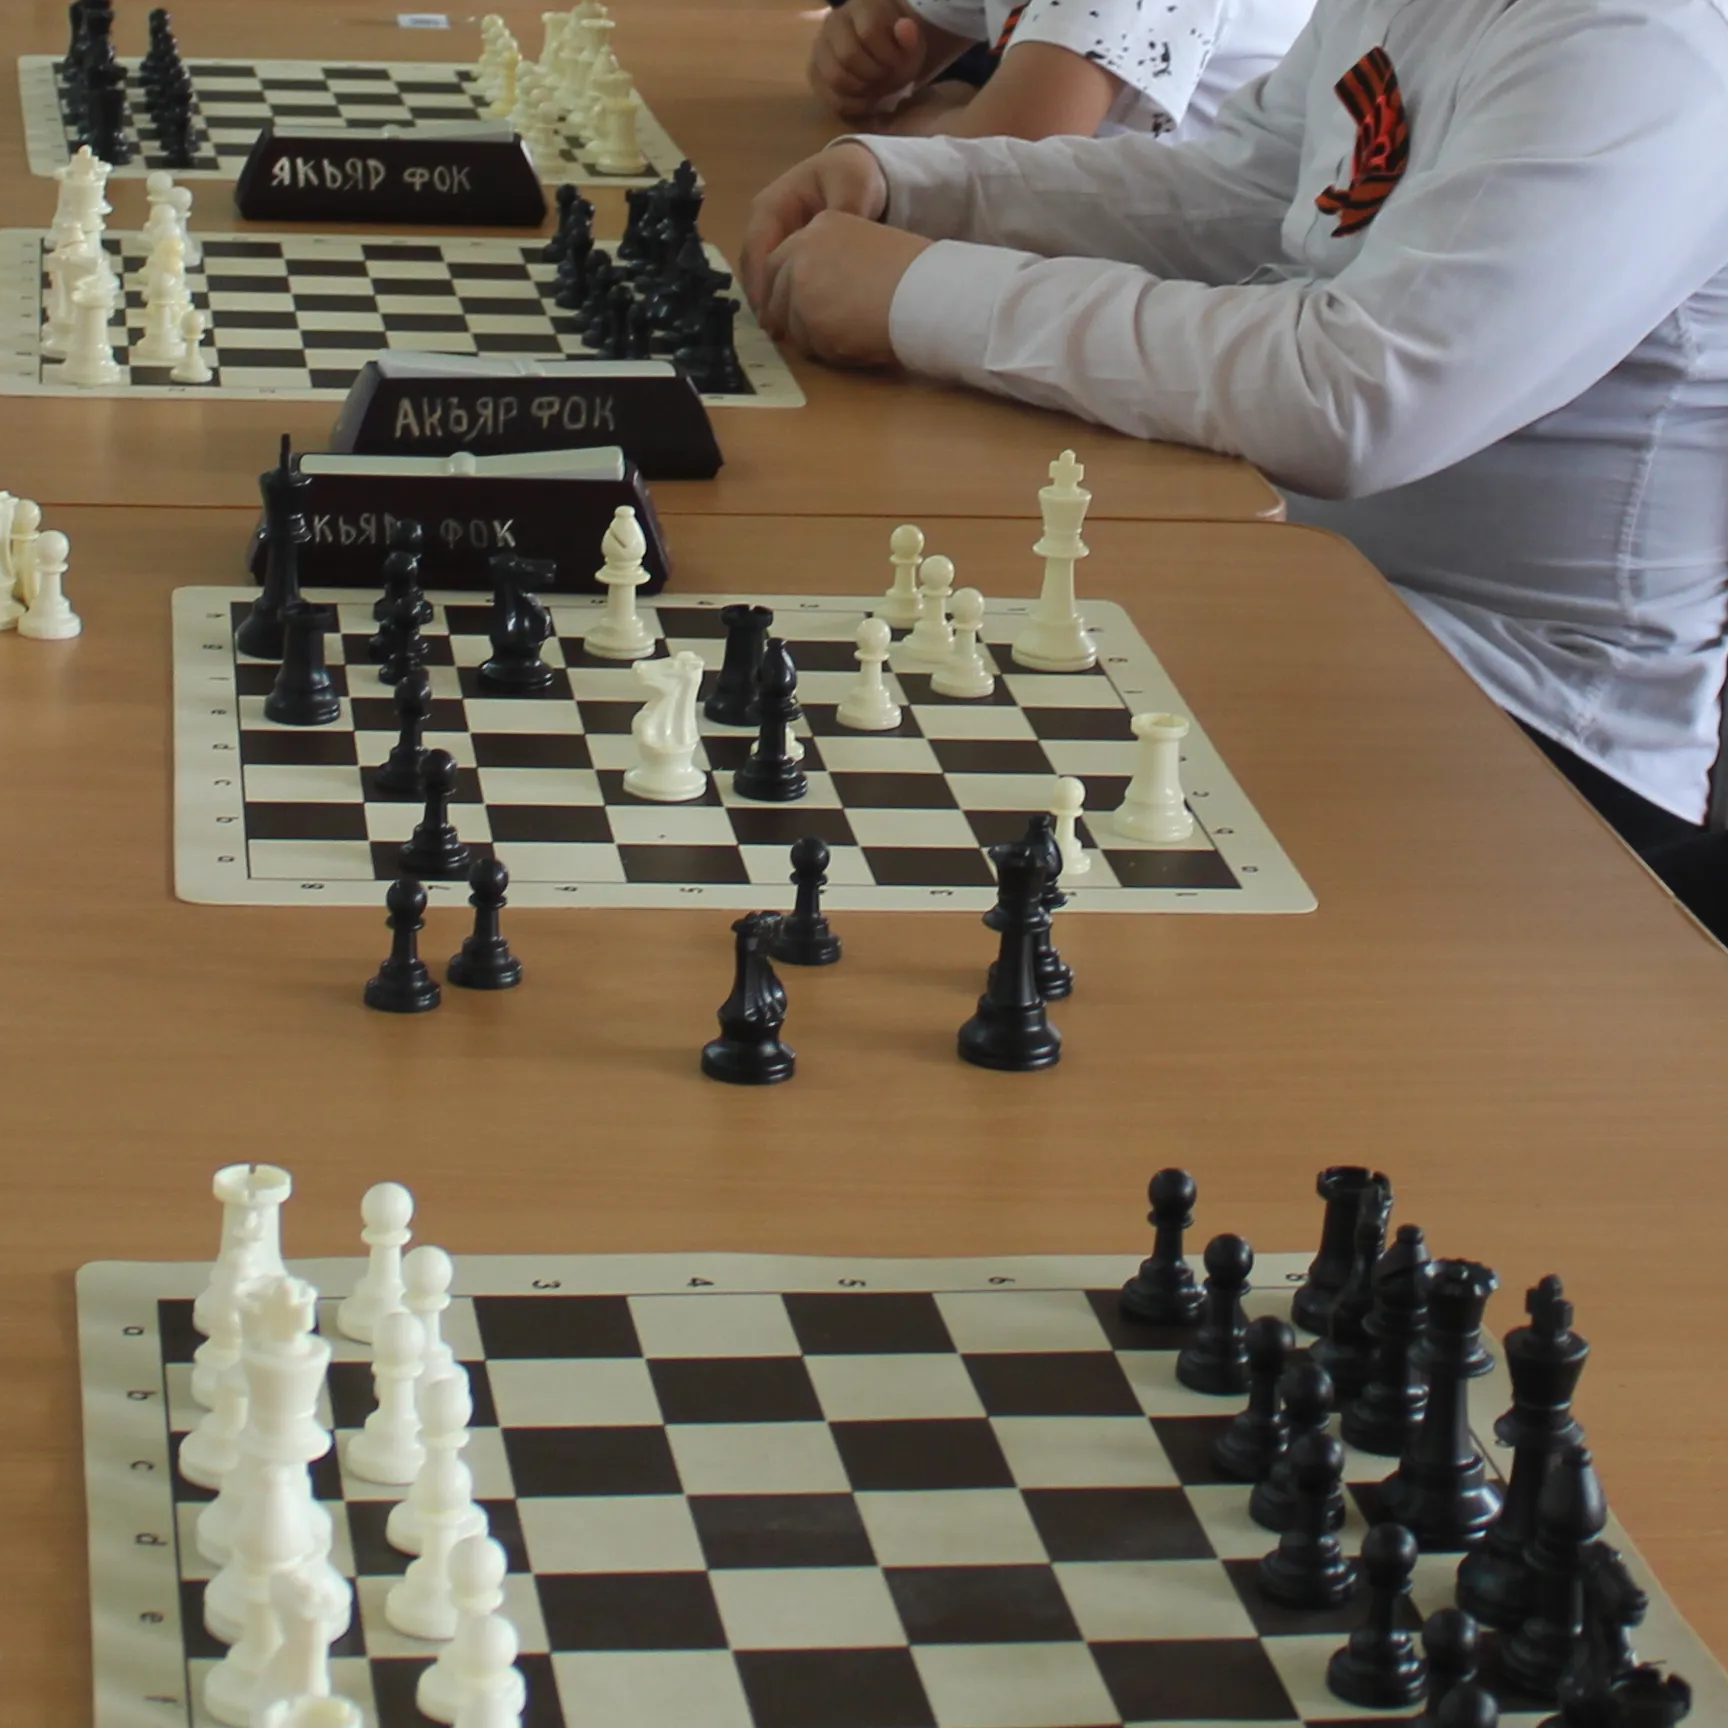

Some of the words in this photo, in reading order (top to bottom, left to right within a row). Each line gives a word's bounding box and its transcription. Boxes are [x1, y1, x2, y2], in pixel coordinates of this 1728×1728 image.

[402, 164, 472, 195] ФОК
[529, 395, 616, 433] ФОК
[439, 517, 517, 550] ФОК
